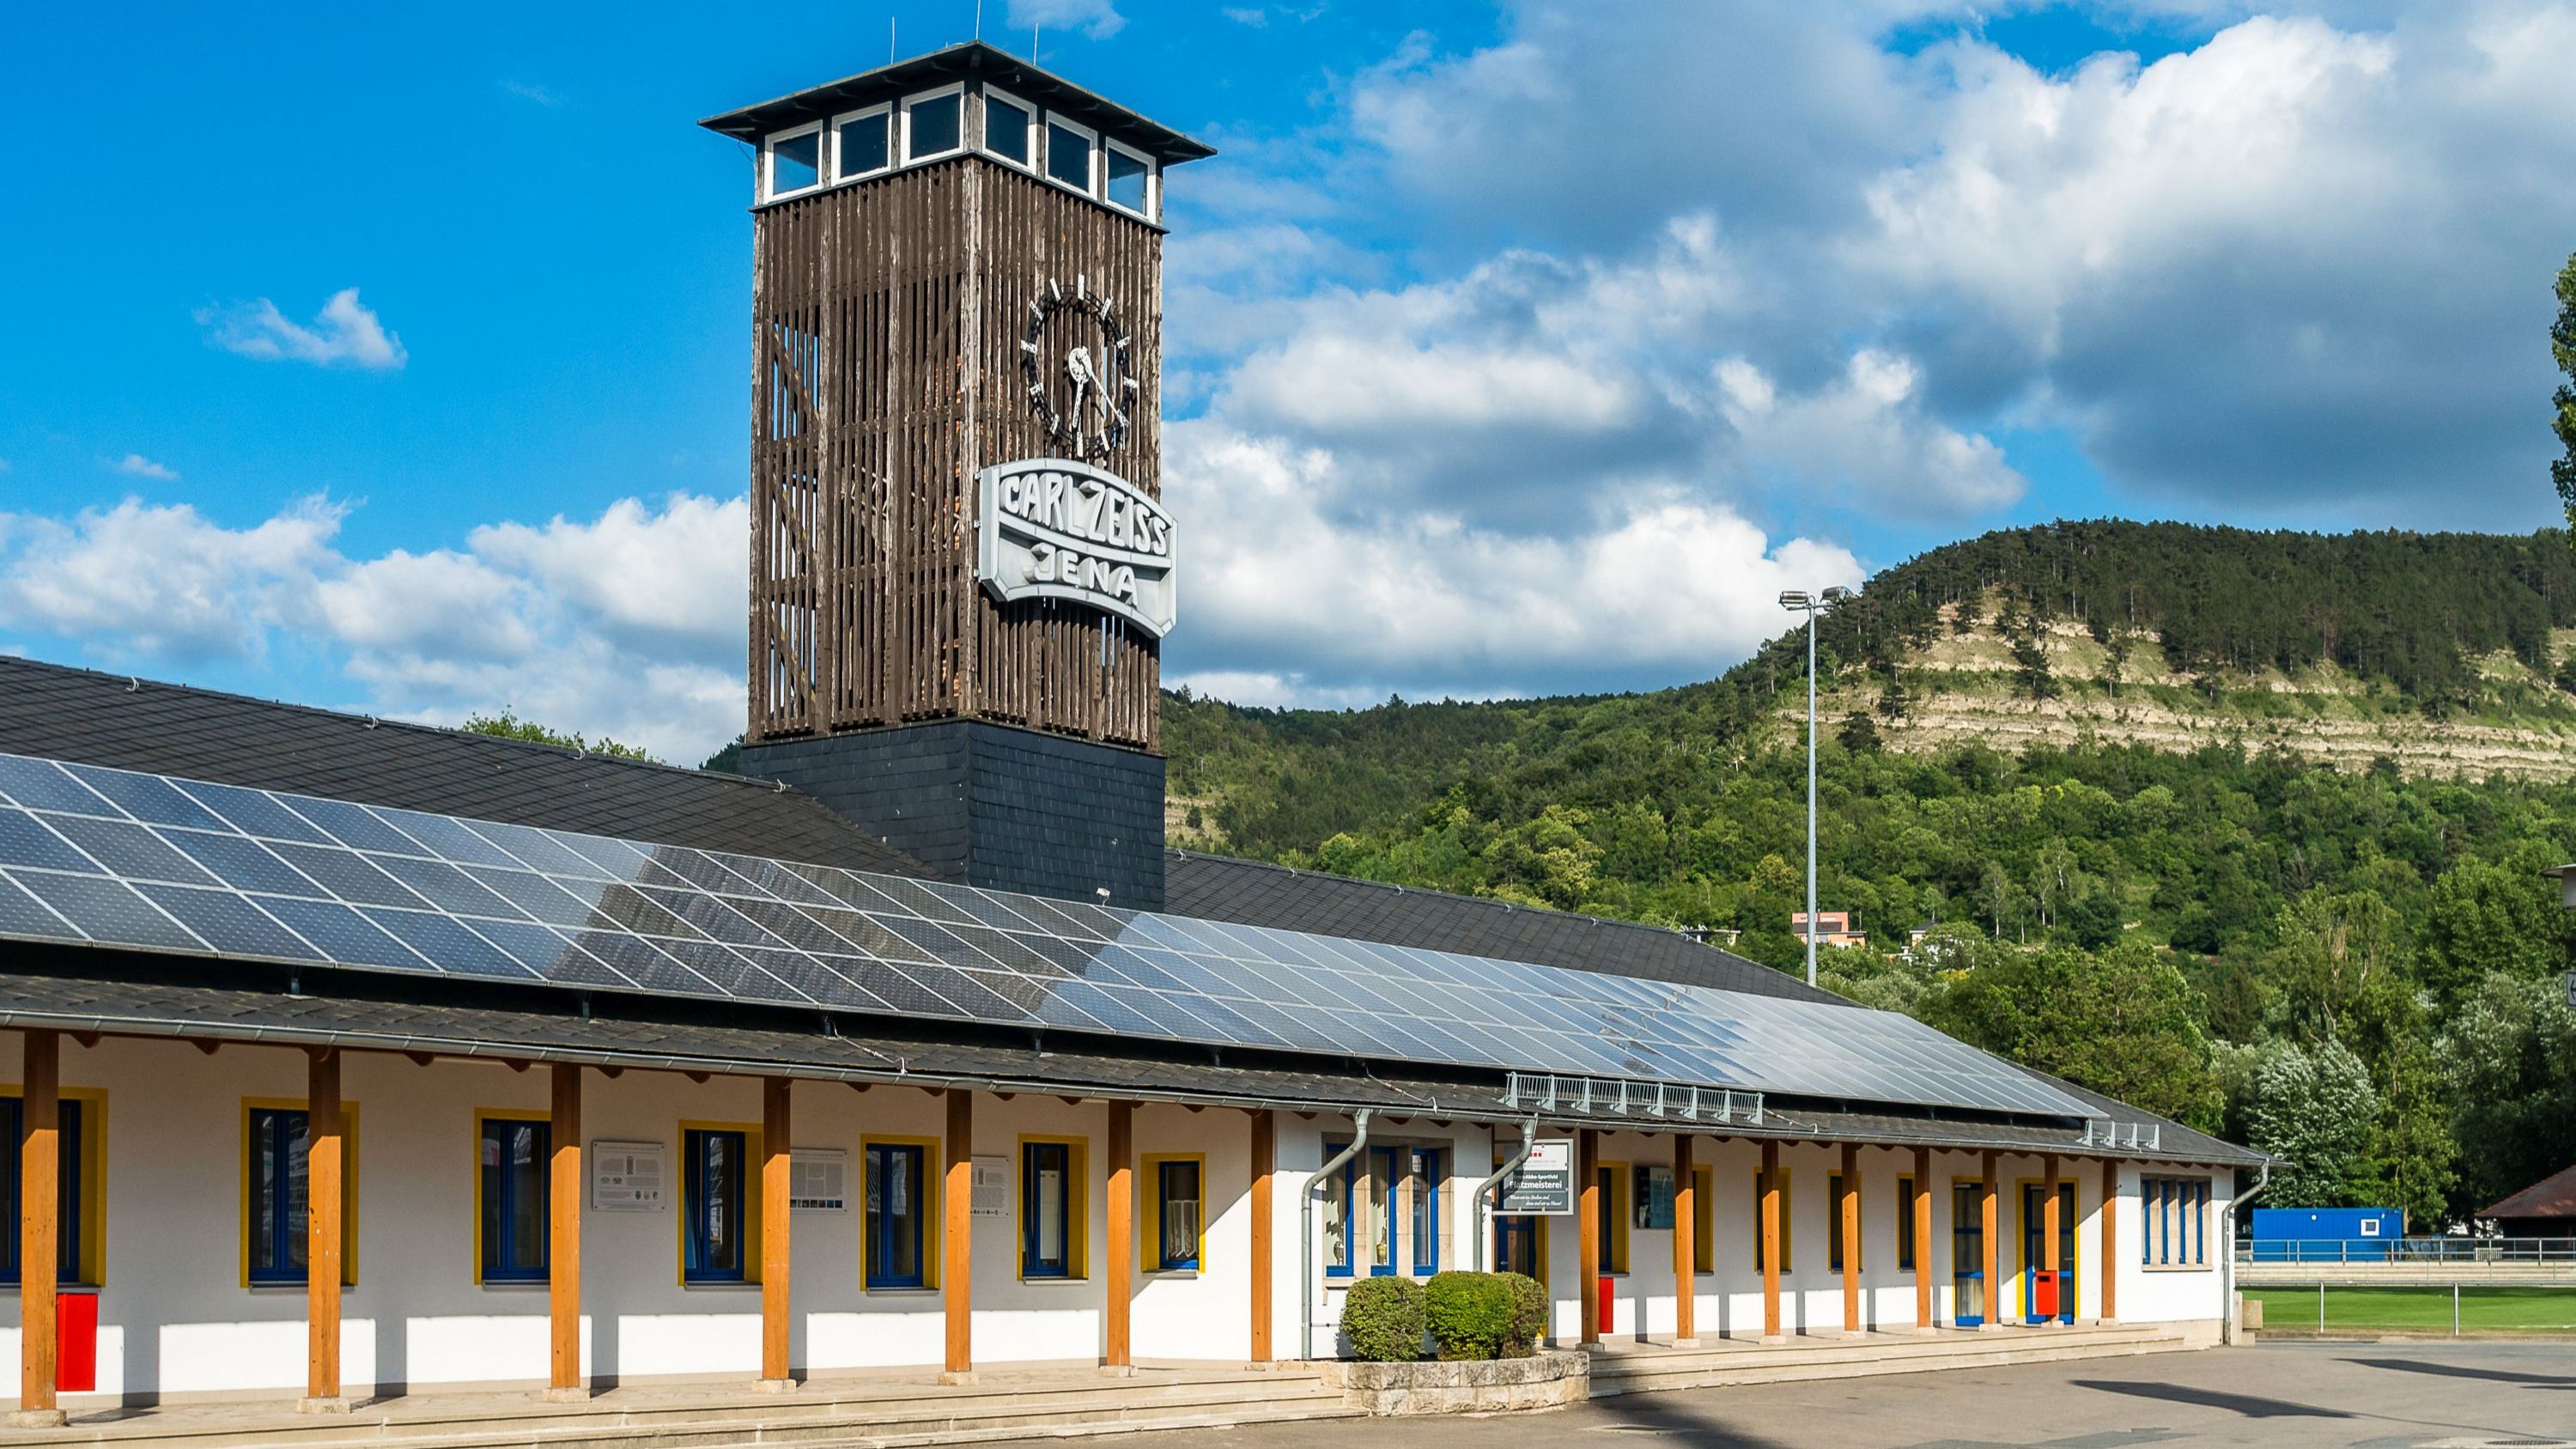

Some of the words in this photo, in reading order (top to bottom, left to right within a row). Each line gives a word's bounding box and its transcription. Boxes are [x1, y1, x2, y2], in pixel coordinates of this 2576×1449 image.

[999, 472, 1085, 539] CARL
[1079, 479, 1167, 556] ZEISS
[1029, 542, 1139, 609] JENA
[1509, 1180, 1563, 1189] Platzmeisterei
